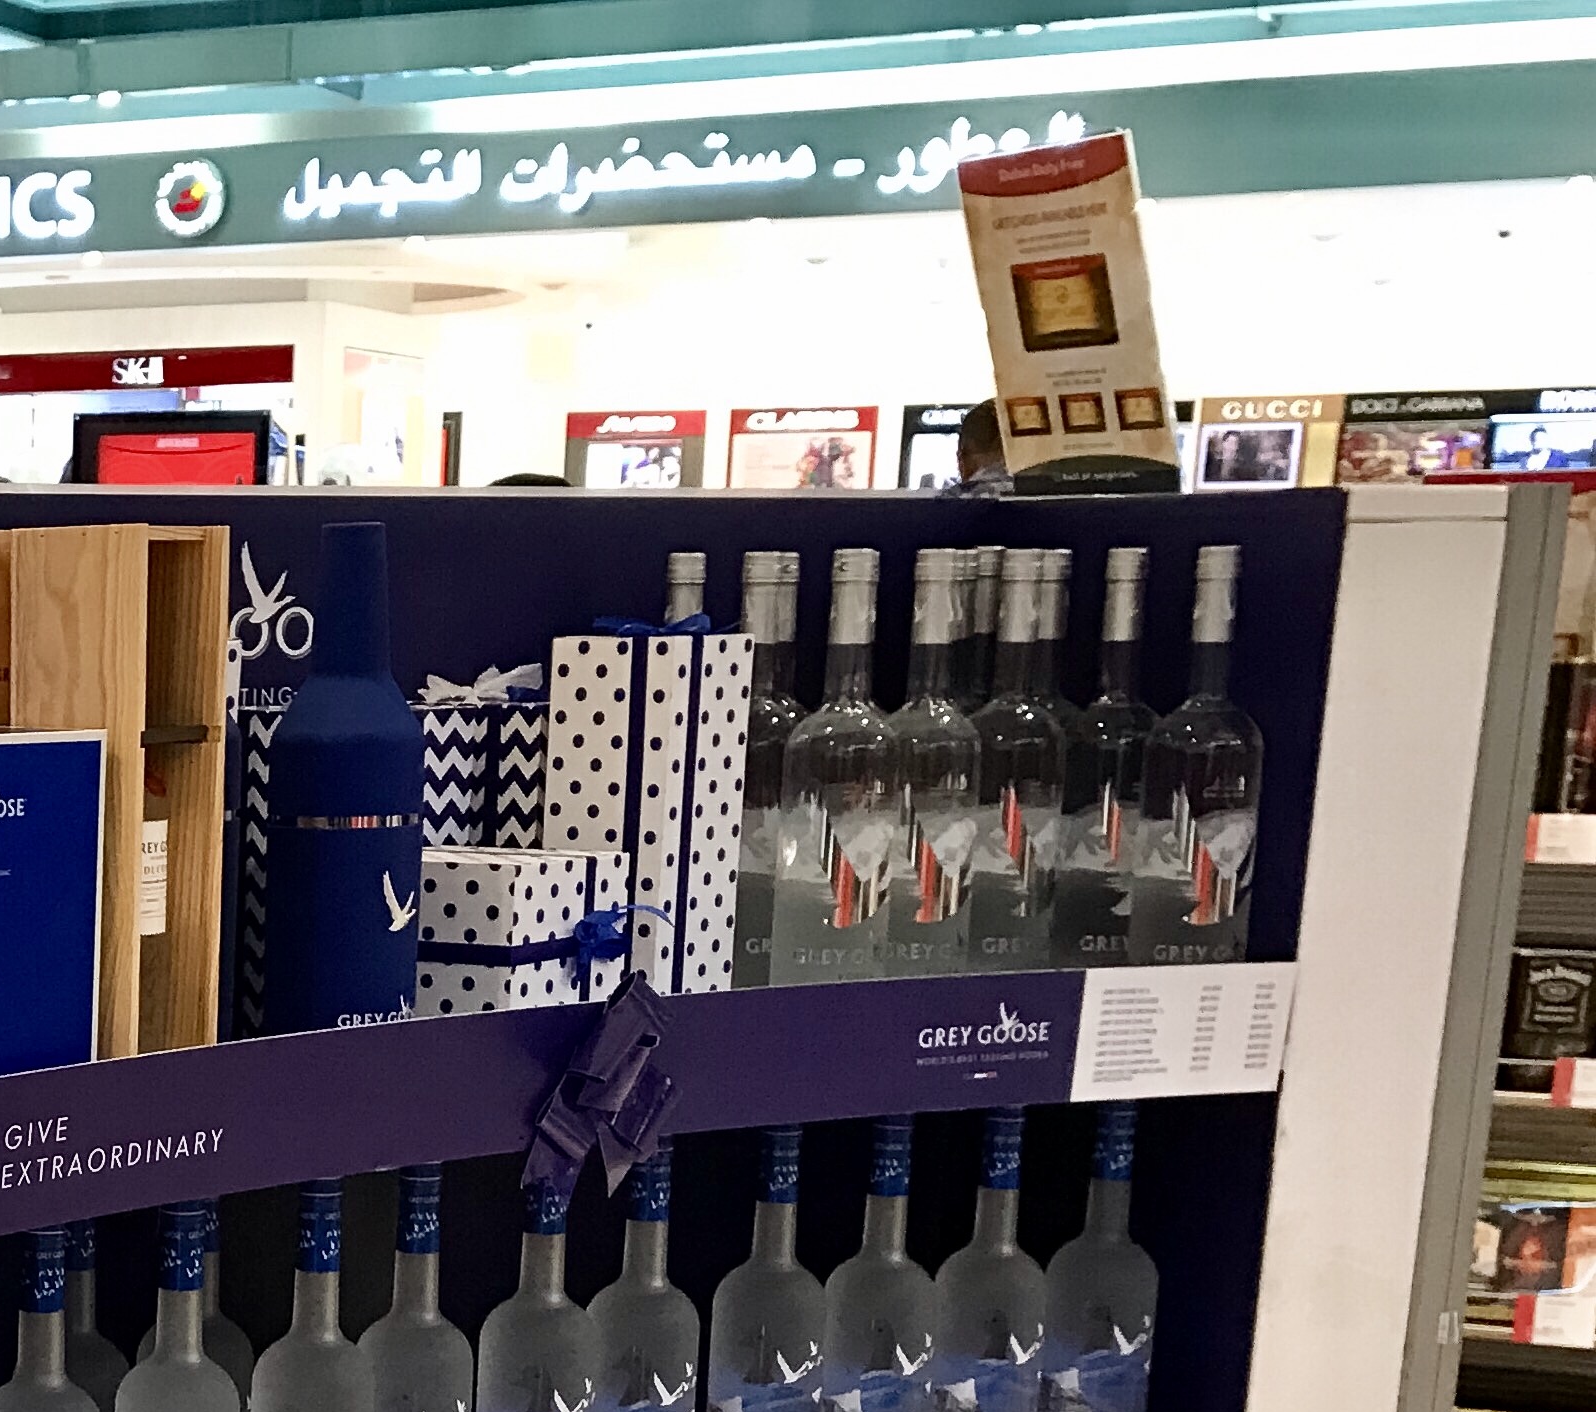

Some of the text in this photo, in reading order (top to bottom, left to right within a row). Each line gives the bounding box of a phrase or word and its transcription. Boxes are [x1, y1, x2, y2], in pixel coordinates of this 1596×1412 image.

[500, 132, 817, 213] مستحضرات
[1220, 399, 1323, 420] GUCCI
[337, 1012, 384, 1028] GREY
[918, 1021, 1052, 1048] GREY GOOSE
[4, 1116, 70, 1150] GIVE
[0, 1128, 224, 1189] EXTRAORDINARY
